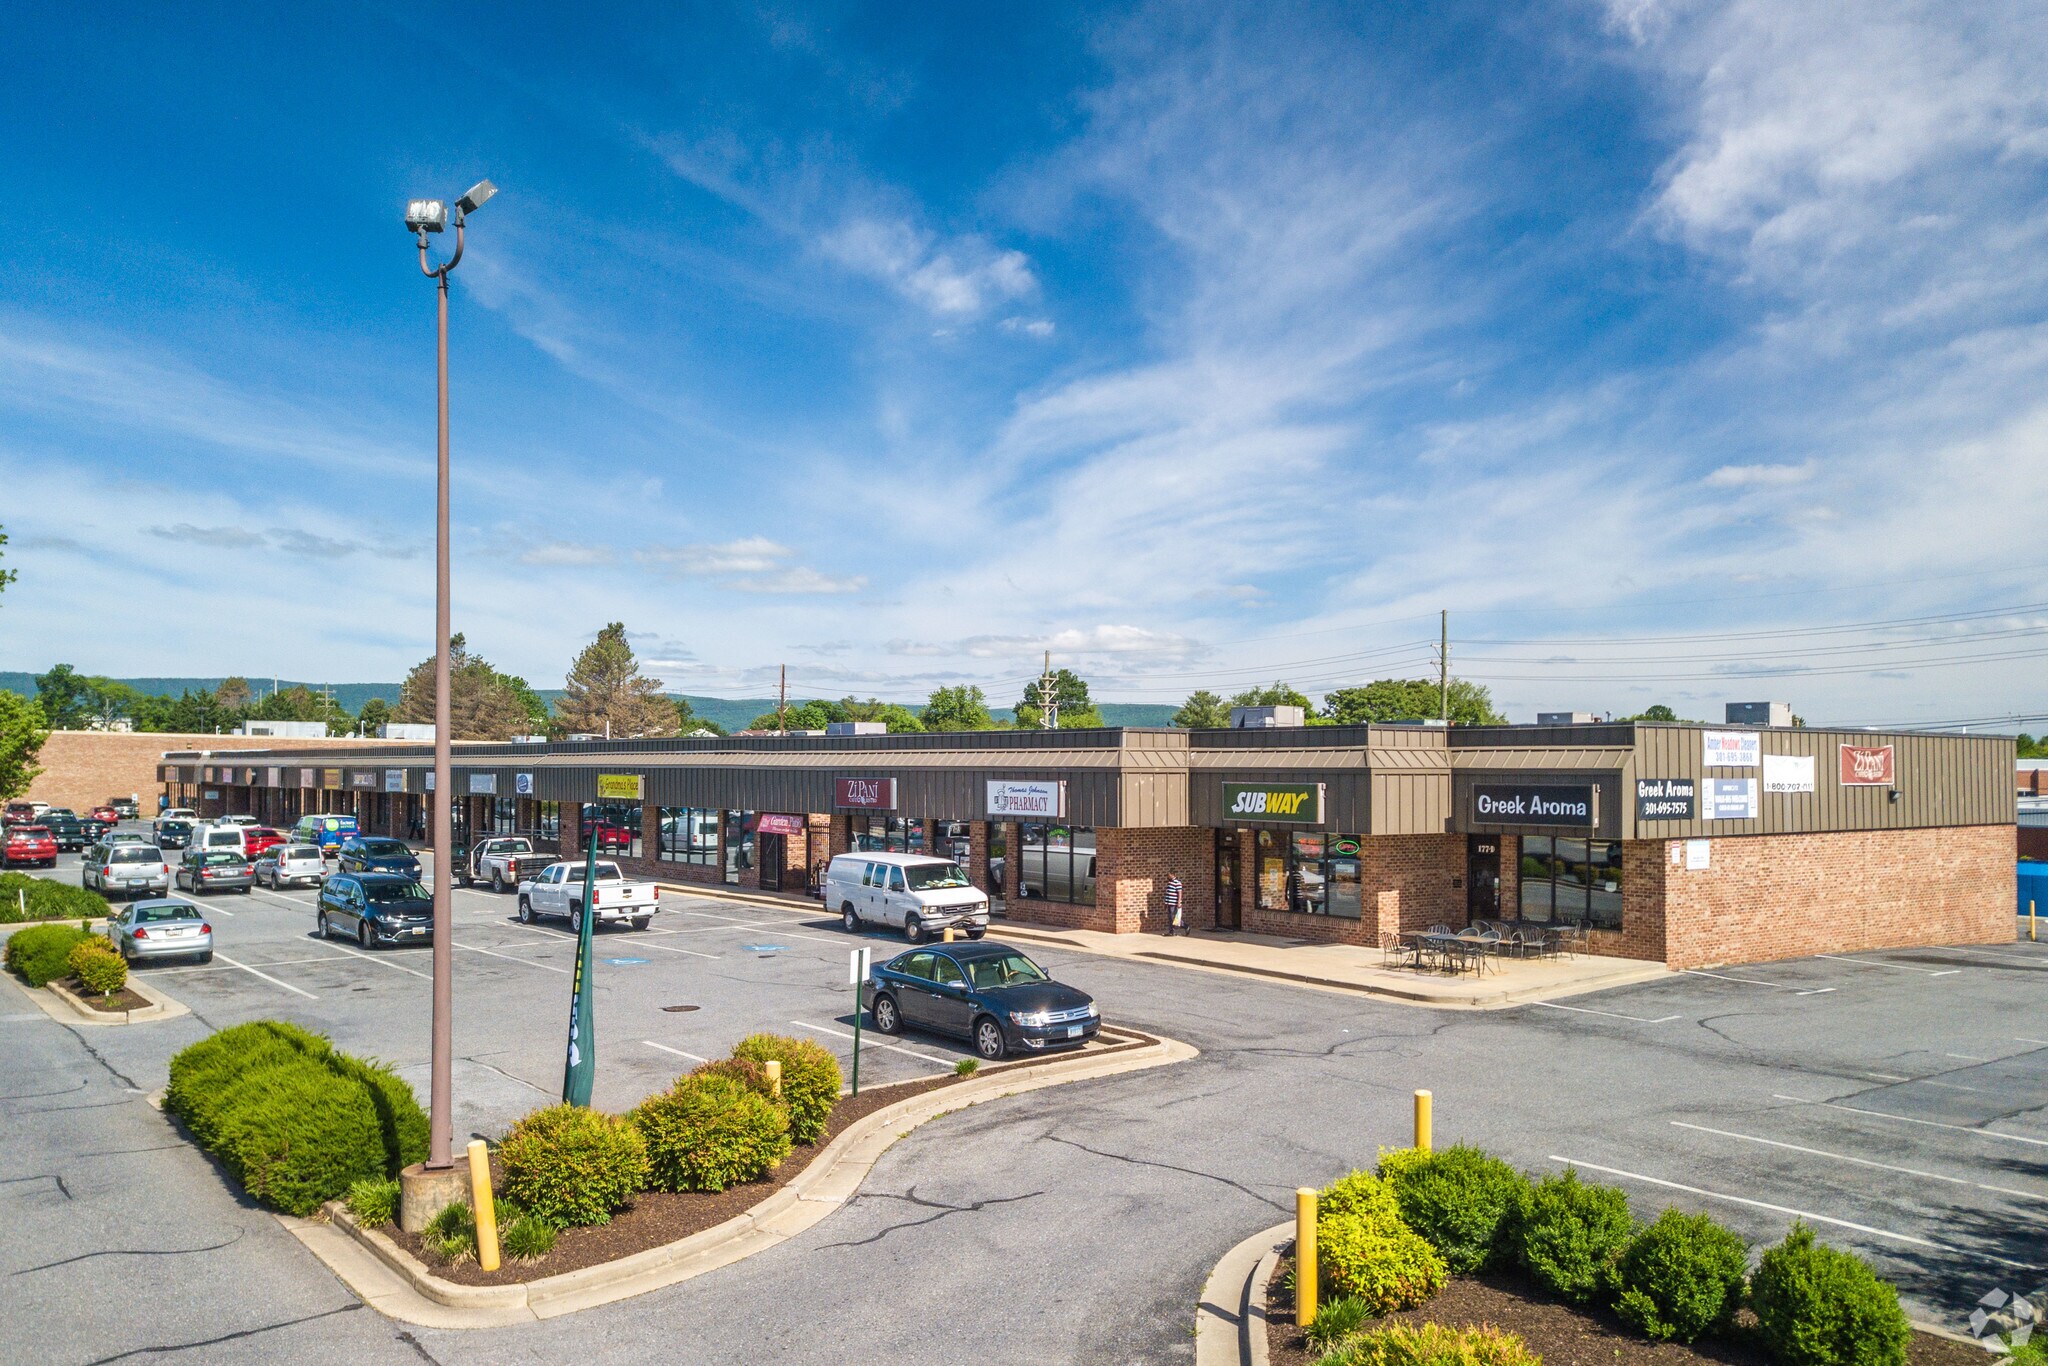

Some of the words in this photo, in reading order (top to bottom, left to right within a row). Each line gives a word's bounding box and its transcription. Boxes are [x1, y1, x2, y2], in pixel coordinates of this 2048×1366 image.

[1638, 780, 1664, 798] Greek
[1665, 780, 1694, 797] Aroma
[1009, 796, 1048, 811] PHARMACY
[1231, 791, 1309, 814] SUBWAY
[1478, 795, 1526, 814] Greek
[1529, 795, 1587, 816] Aroma
[1645, 801, 1687, 815] 301-695-7575
